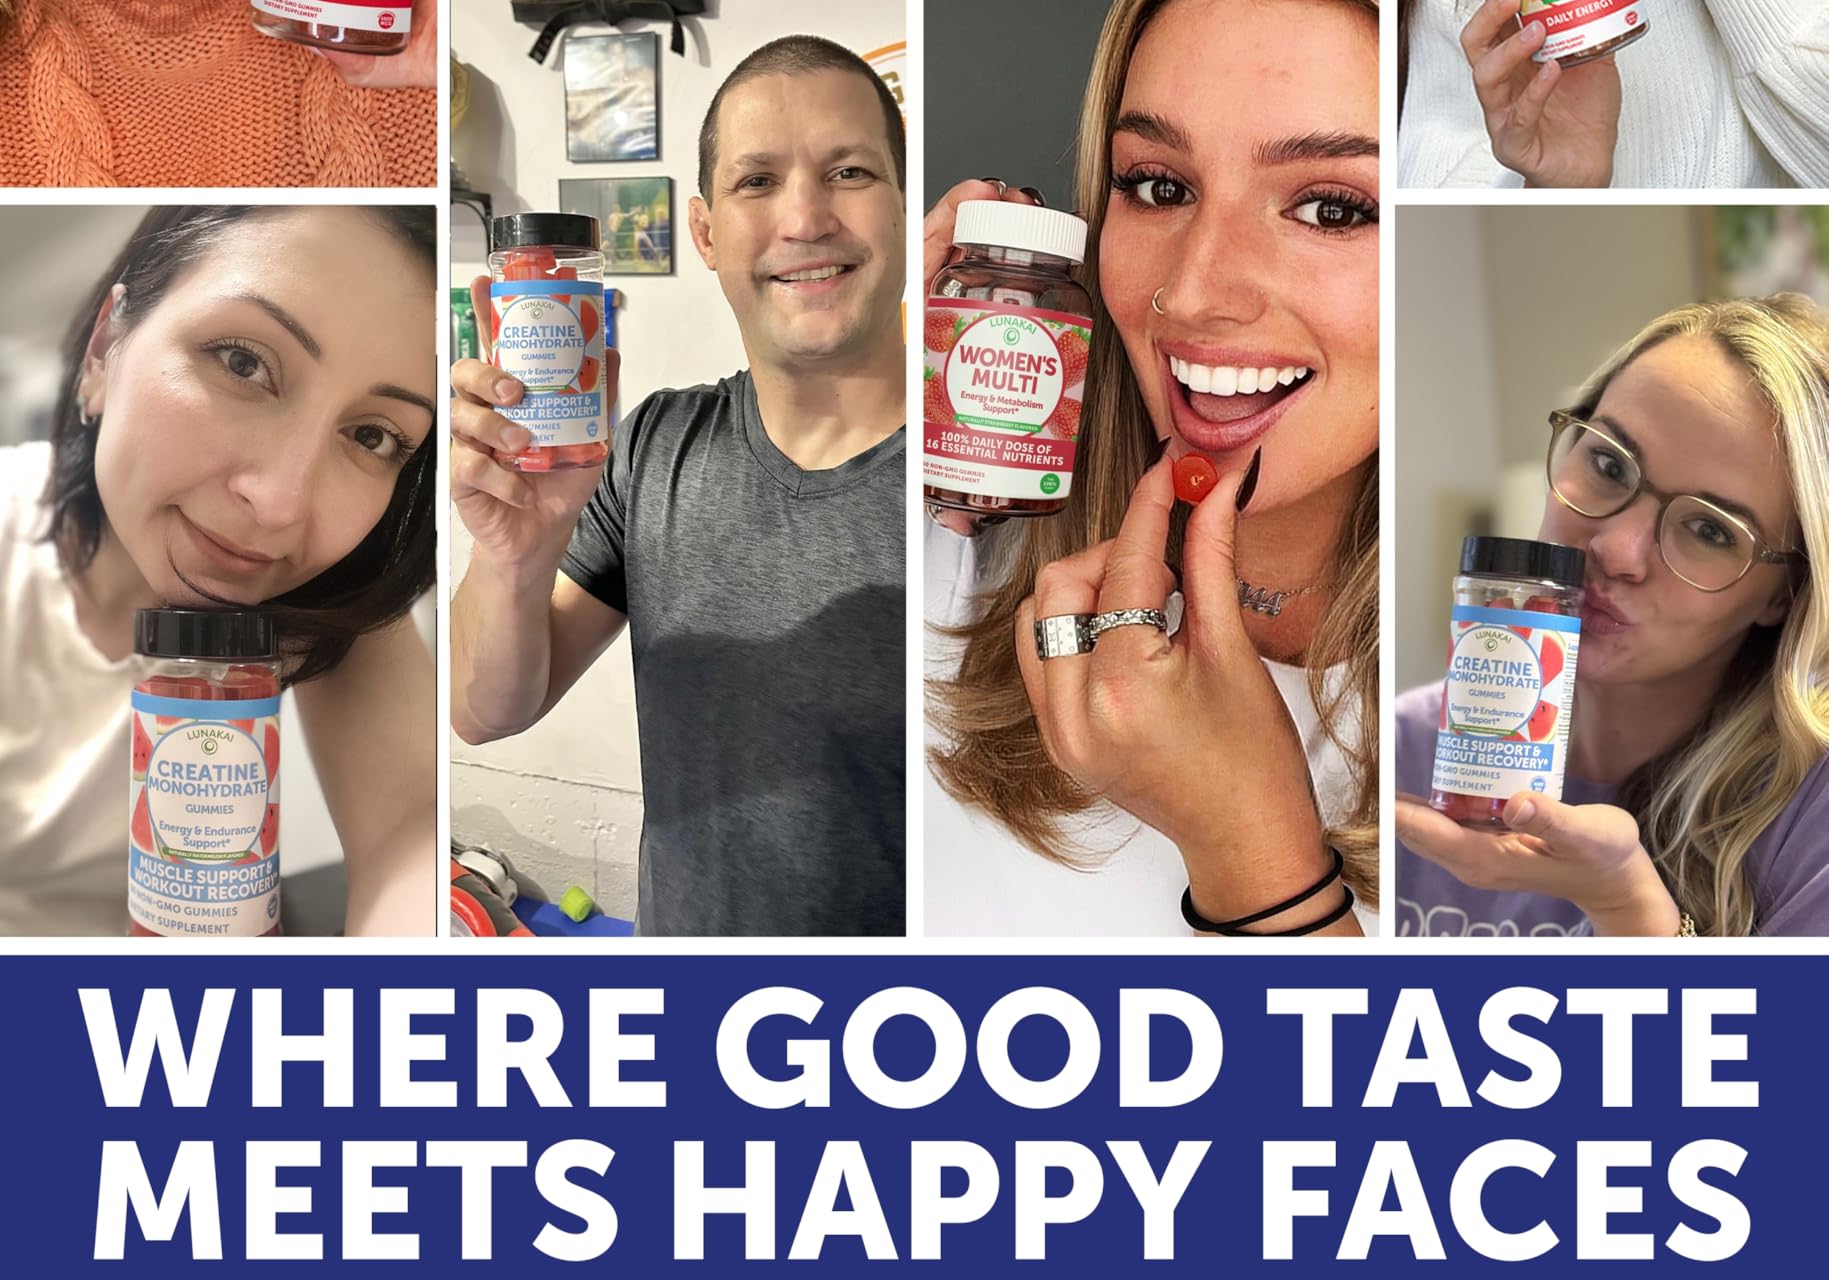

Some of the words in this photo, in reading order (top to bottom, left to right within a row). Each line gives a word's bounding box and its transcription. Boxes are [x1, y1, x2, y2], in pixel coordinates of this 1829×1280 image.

[264, 0, 284, 10] DIETARY
[284, 7, 318, 18] SUPPLEMENT
[298, 3, 322, 13] GUMMIES
[1546, 10, 1574, 27] DAILY
[521, 301, 555, 311] LUNAKAI
[504, 325, 575, 338] CREATINE
[990, 317, 1037, 335] LUNAKAI
[498, 338, 583, 350] MONOHYDRATE
[959, 345, 1057, 376] WOMEN'S
[971, 368, 1038, 394] MULTI
[531, 396, 583, 407] SUPPORT
[585, 396, 591, 404] &
[960, 391, 988, 402] Energy
[997, 396, 1043, 409] Metabolism
[941, 432, 969, 444] 100%
[972, 436, 1003, 449] DAILY
[1005, 440, 1034, 453] DOSE
[1037, 445, 1052, 454] OF
[926, 439, 939, 449] 16
[941, 442, 997, 459] ESSENTIAL
[1003, 451, 1064, 465] NUTRIENTS
[930, 463, 958, 473] NON-GMO
[959, 468, 985, 477] GUMMIES
[945, 473, 980, 483] SUPPLEMENT
[1476, 632, 1512, 643] LUNAKAI
[1455, 656, 1532, 677] CREATINE
[1468, 689, 1506, 699] GUMMIES
[1451, 704, 1472, 714] Energy
[1480, 707, 1525, 719] Endurance
[187, 729, 233, 742] LUNAKAI
[1437, 747, 1476, 763] ORKOUT
[1471, 741, 1532, 756] SUPPORT
[1533, 746, 1541, 756] &
[157, 760, 259, 782] CREATINE
[1459, 767, 1501, 779] GUMMIES
[149, 776, 266, 797] MONOHYDRATE
[1442, 778, 1493, 792] SUPPLEMENT
[185, 804, 234, 814] GUMMIES
[159, 821, 193, 836] Energy
[194, 825, 202, 835] &
[204, 824, 256, 836] Endurance
[139, 856, 192, 882] MUSCLE
[197, 864, 265, 884] SUPPORT
[266, 861, 272, 874] &
[134, 867, 204, 898] WORKOUT
[184, 906, 238, 918] GUMMIES
[158, 916, 230, 934] SUPPLEMENT
